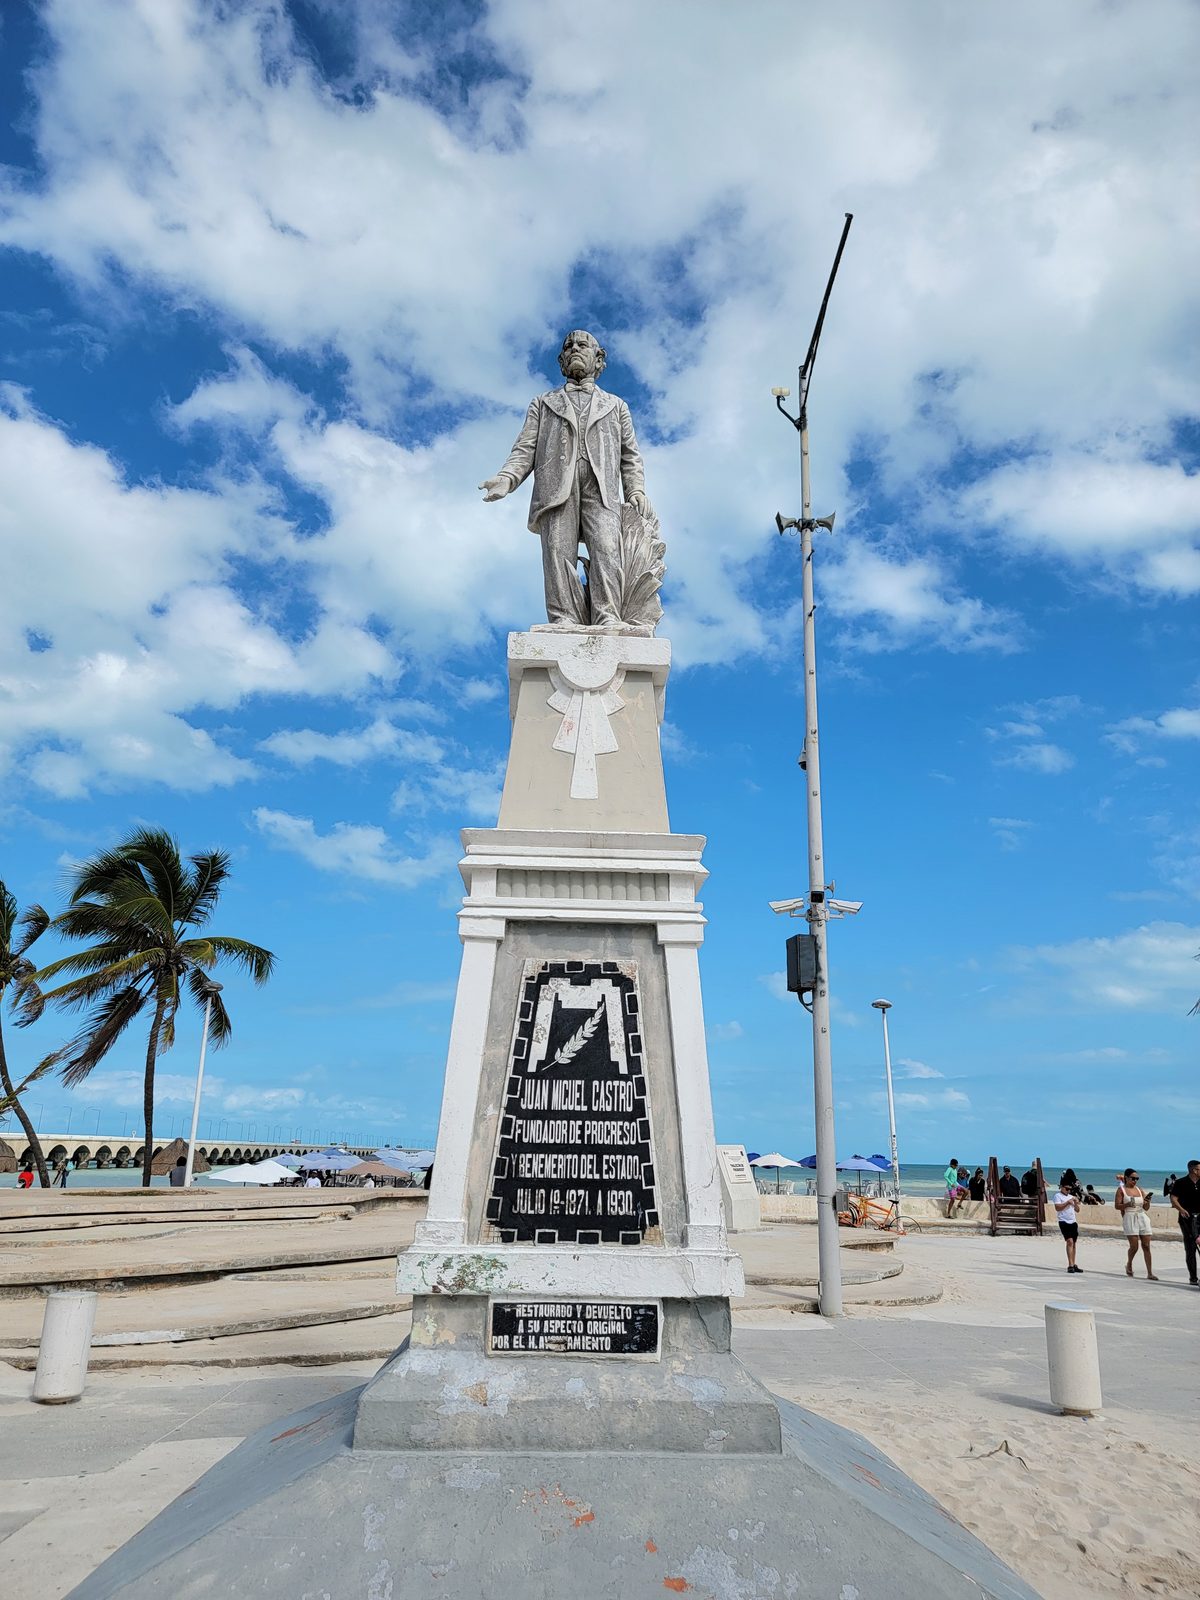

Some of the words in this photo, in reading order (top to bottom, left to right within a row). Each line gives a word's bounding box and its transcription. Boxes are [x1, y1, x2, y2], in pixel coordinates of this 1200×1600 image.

[520, 1079, 549, 1111] JUAN
[551, 1080, 588, 1112] MIGUEL
[591, 1080, 633, 1112] CASTRO
[515, 1119, 568, 1143] FUNDADOR
[569, 1120, 583, 1144] DE
[584, 1121, 637, 1145] PROGRESO
[511, 1153, 518, 1178] Y
[518, 1153, 578, 1179] BENEMERITO
[580, 1154, 600, 1179] DEL
[602, 1155, 642, 1180] ESTADO.
[512, 1188, 546, 1214] JULIO
[596, 1190, 603, 1216] A
[516, 1304, 573, 1318] RESTAURADO
[576, 1305, 583, 1318] Y
[585, 1305, 632, 1319] DEVUELTO
[518, 1319, 524, 1333] A
[528, 1320, 540, 1333] SU
[543, 1320, 583, 1334] ASPECTO
[586, 1320, 627, 1335] ORIGINAL
[492, 1335, 509, 1349] POR
[513, 1335, 525, 1349] EL
